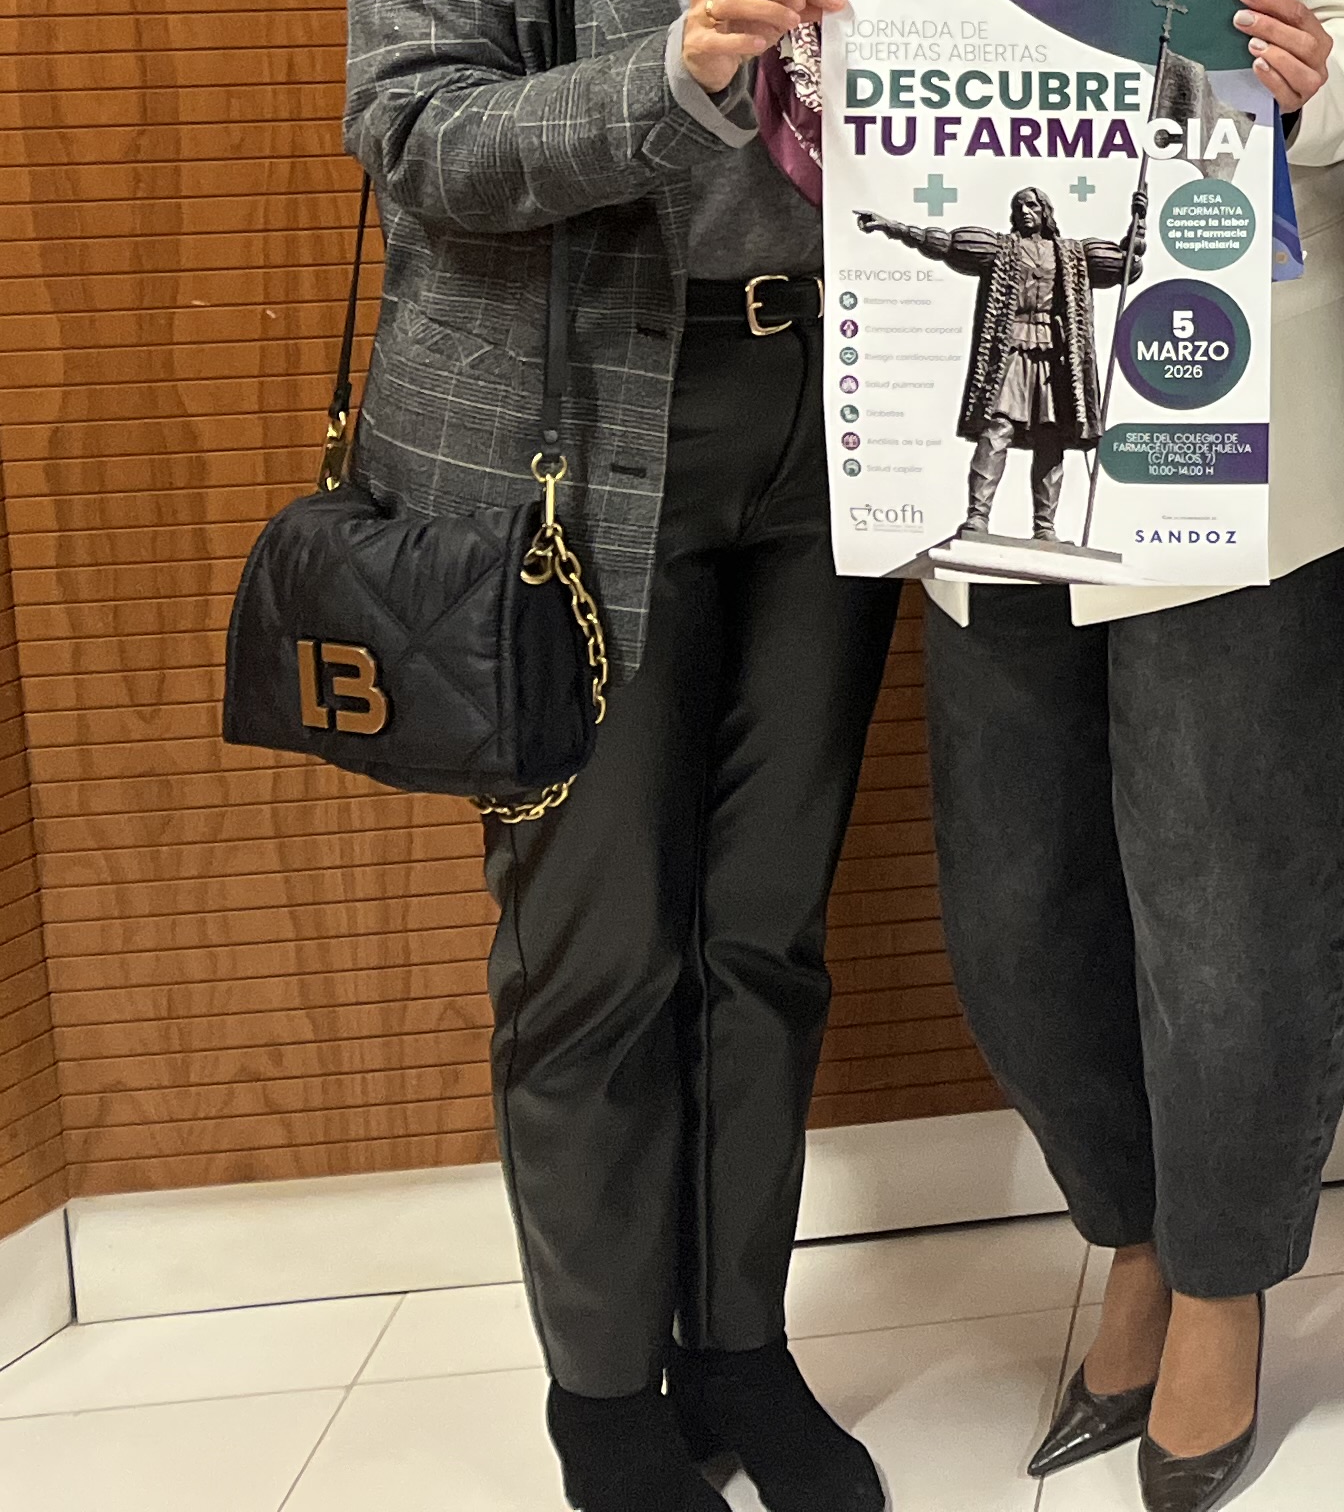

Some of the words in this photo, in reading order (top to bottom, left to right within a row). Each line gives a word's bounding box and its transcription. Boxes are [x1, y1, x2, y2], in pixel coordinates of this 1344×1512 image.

[846, 19, 953, 39] JORNADA
[961, 20, 988, 39] DE
[845, 42, 940, 62] PUERTAS
[948, 44, 1048, 63] ABIERTAS
[845, 68, 1140, 112] DESCUBRE
[844, 115, 917, 156] TU
[934, 116, 1246, 160] FARMACIA
[1194, 194, 1222, 204] MESA
[1172, 207, 1242, 216] INFORMATIVA
[1166, 218, 1206, 227] Conoce
[1208, 218, 1219, 227] la
[1222, 218, 1249, 227] labor
[1168, 229, 1182, 238] de
[1184, 229, 1195, 238] la
[1197, 229, 1247, 238] Farmacia
[1175, 241, 1240, 251] Hospitalaria
[839, 269, 912, 282] SERVICIOS
[1172, 310, 1194, 339] 5
[1137, 340, 1229, 361] MARZO
[1164, 365, 1203, 378] 2026
[1126, 433, 1150, 443] SEDE
[1154, 433, 1171, 443] DEL
[1174, 433, 1222, 443] COLEGIO
[1224, 434, 1238, 443] DE
[1196, 443, 1210, 453] DE
[1212, 443, 1251, 454] HUELVA
[1206, 466, 1214, 475] H
[873, 504, 923, 524] cofh
[1136, 530, 1237, 544] SANDOZ
